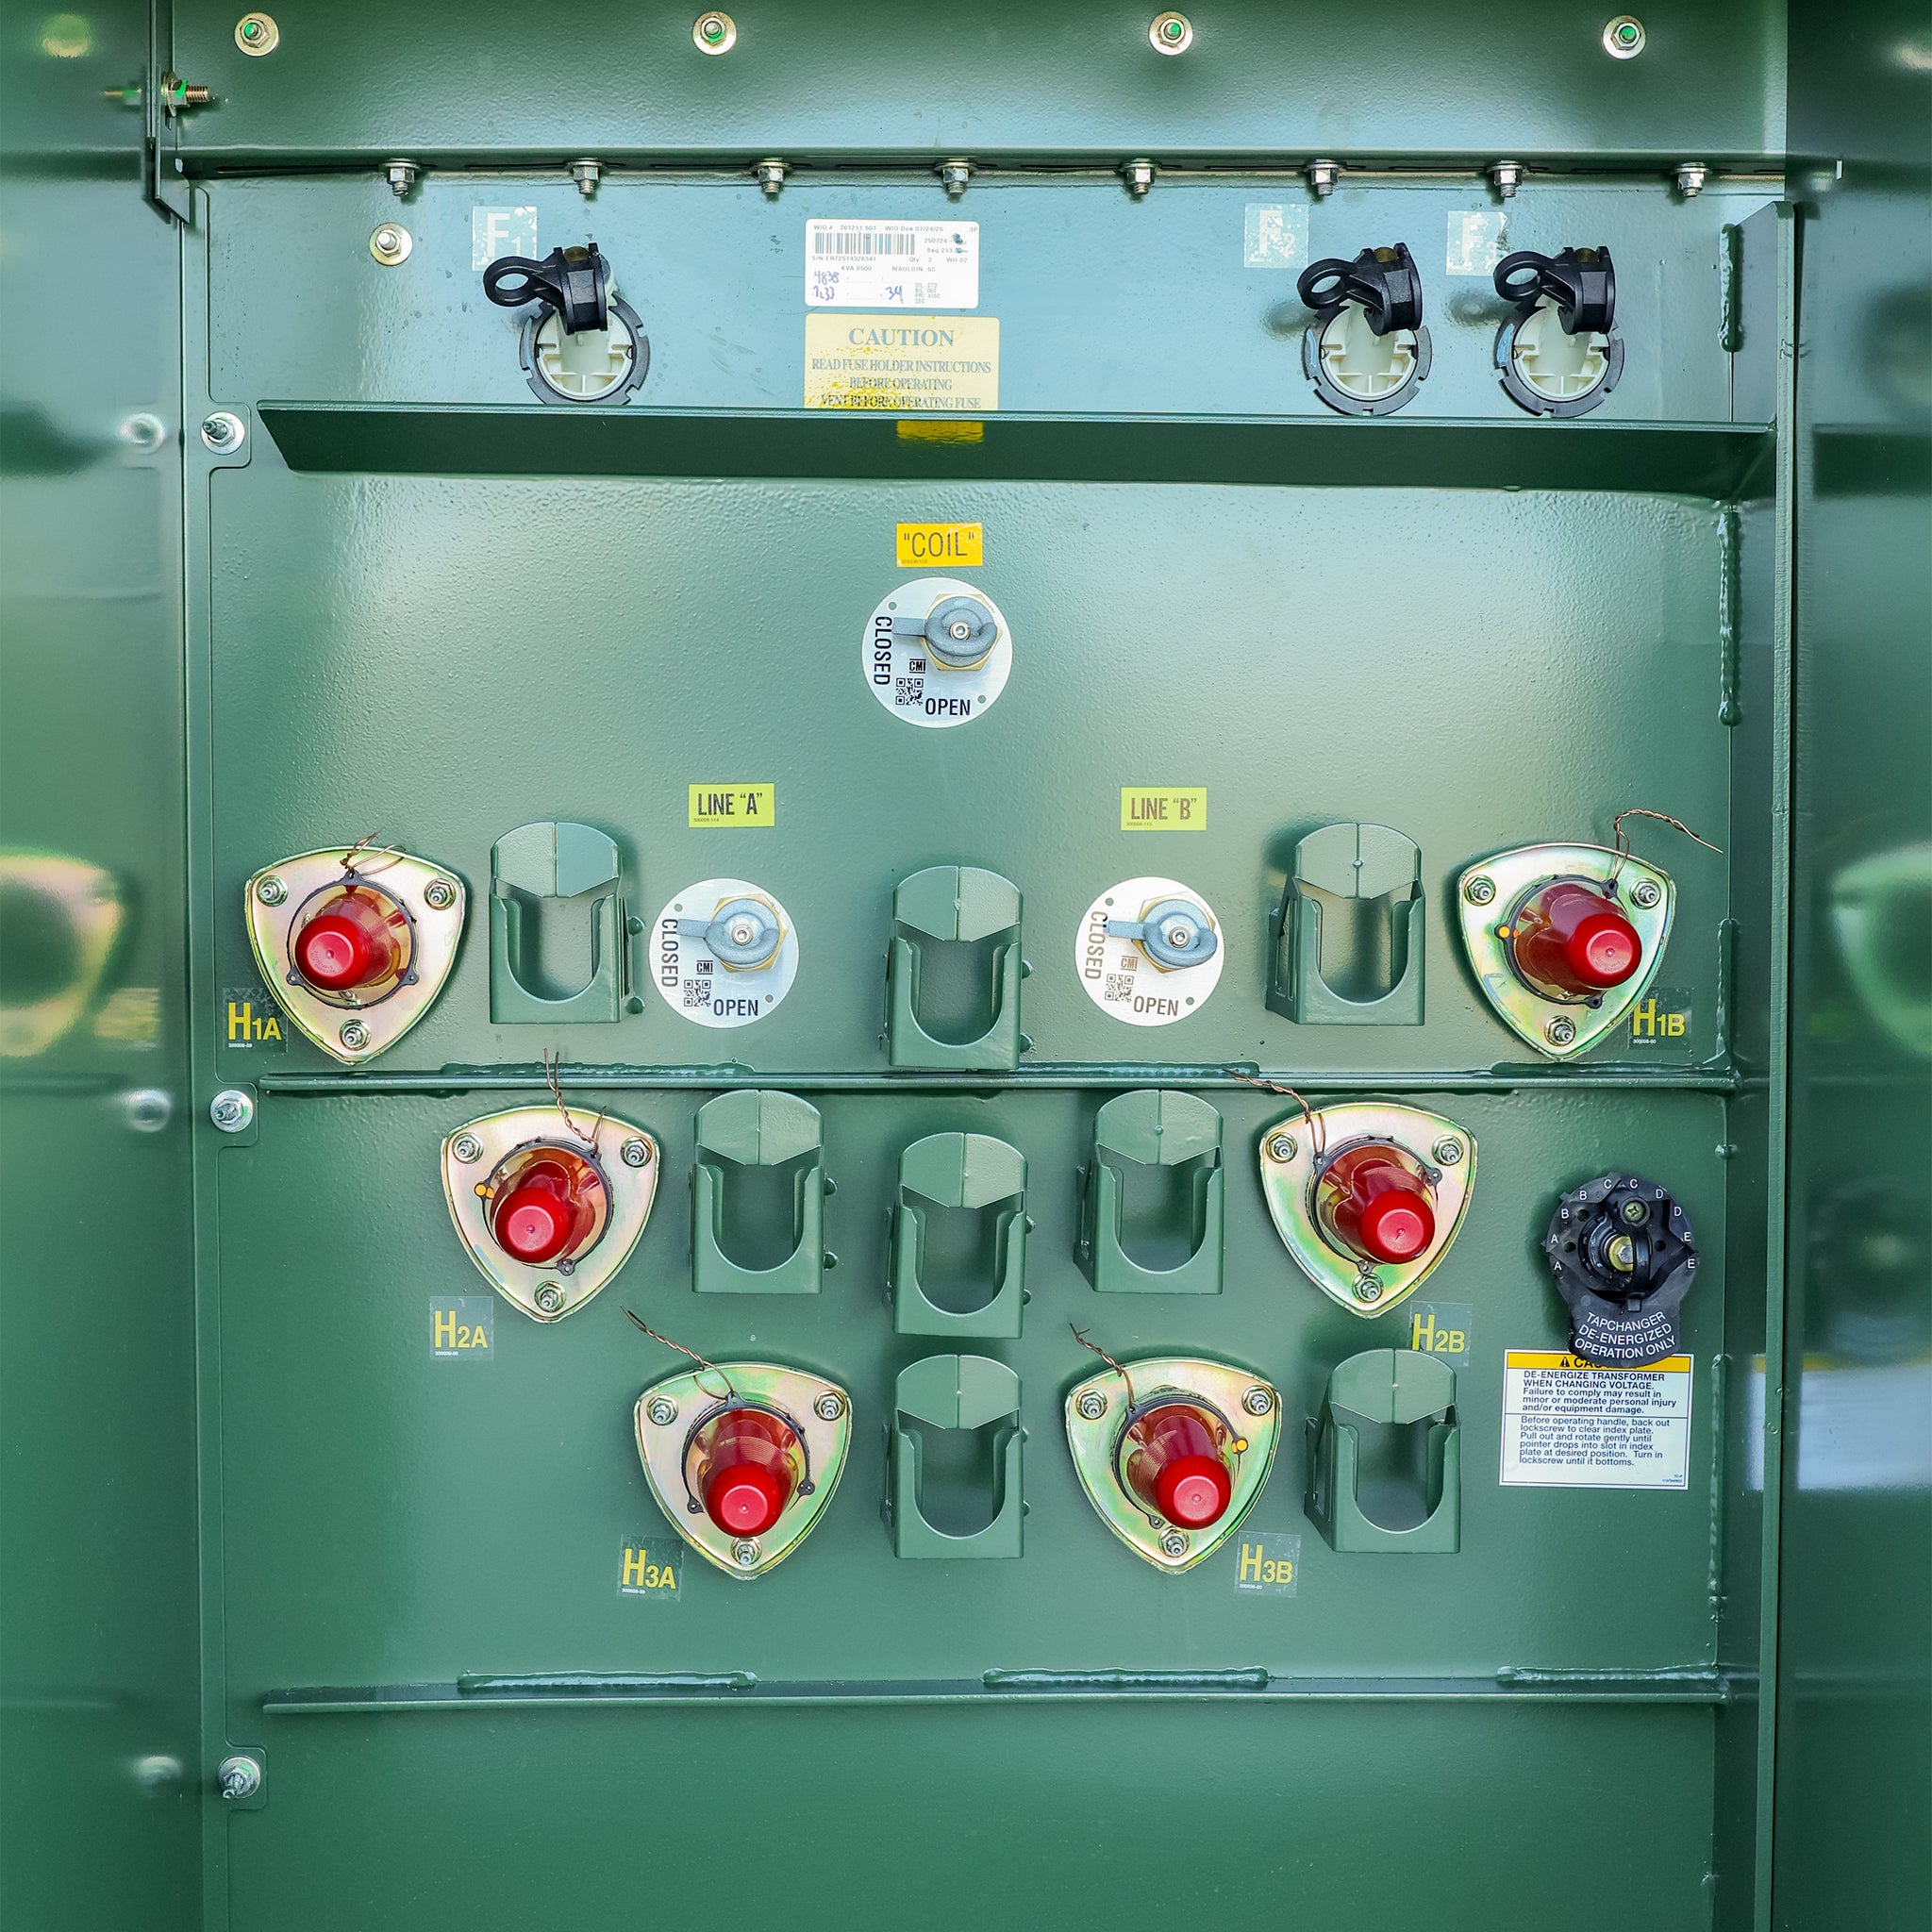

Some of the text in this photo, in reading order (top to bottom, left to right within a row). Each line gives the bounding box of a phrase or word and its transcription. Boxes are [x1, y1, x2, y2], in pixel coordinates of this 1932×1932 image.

[849, 328, 955, 346] CAUTION
[812, 358, 991, 374] READ FUSE HOLDER INSTRUCTIONS
[849, 377, 952, 391] BEFORE OPERATING
[955, 397, 981, 408] FUSE
[904, 532, 974, 558] "COIL"
[874, 616, 892, 686] CLOSED
[908, 660, 926, 672] CMI
[924, 697, 971, 716] OPEN
[698, 793, 735, 816] LINE
[1131, 797, 1168, 820] LINE
[1084, 910, 1108, 980] CLOSED
[661, 918, 679, 988] CLOSED
[696, 962, 713, 974] CMI
[1121, 957, 1138, 969] CMI
[713, 999, 759, 1016] OPEN
[1133, 995, 1179, 1016] OPEN
[228, 1002, 282, 1041] H1A
[1633, 998, 1686, 1037] H1B
[1604, 1179, 1612, 1189] C
[1629, 1179, 1638, 1189] C
[1579, 1191, 1588, 1201] B
[1656, 1190, 1664, 1199] D
[1560, 1208, 1570, 1219] B
[1674, 1207, 1682, 1216] D
[1550, 1234, 1558, 1243] A
[1684, 1232, 1691, 1241] E
[1554, 1261, 1562, 1271] A
[1688, 1259, 1695, 1269] E
[1586, 1311, 1666, 1332] TAPCHANGER
[435, 1310, 489, 1348] H2A
[1411, 1313, 1465, 1353] H2B
[1578, 1323, 1672, 1345] DE-ENERGIZED
[1574, 1336, 1676, 1359] OPERATION ONLY
[1524, 1370, 1665, 1381] DE-ENERGIZE TRANSFORMER
[1555, 1379, 1607, 1389] CHANGING
[1609, 1381, 1655, 1390] VOLTAGE.
[1523, 1387, 1554, 1395] Failure
[1568, 1389, 1601, 1398] comply
[1609, 1398, 1649, 1407] personal
[1652, 1398, 1676, 1408] injury
[1555, 1405, 1603, 1413] equipment
[1605, 1406, 1644, 1415] damage.
[1521, 1415, 1550, 1424] Before
[1552, 1417, 1594, 1426] operating
[1596, 1418, 1629, 1426] handle,
[1520, 1424, 1565, 1432] lockscrew
[1629, 1426, 1654, 1435] plate.
[1520, 1431, 1537, 1440] Pull
[1604, 1435, 1630, 1443] gently
[1553, 1441, 1579, 1450] drops
[1519, 1448, 1541, 1457] plate
[1590, 1450, 1628, 1458] position.
[1633, 1450, 1653, 1458] Turn
[1519, 1456, 1564, 1464] lockscrew
[623, 1548, 676, 1590] H3A
[1240, 1543, 1293, 1584] H3B
